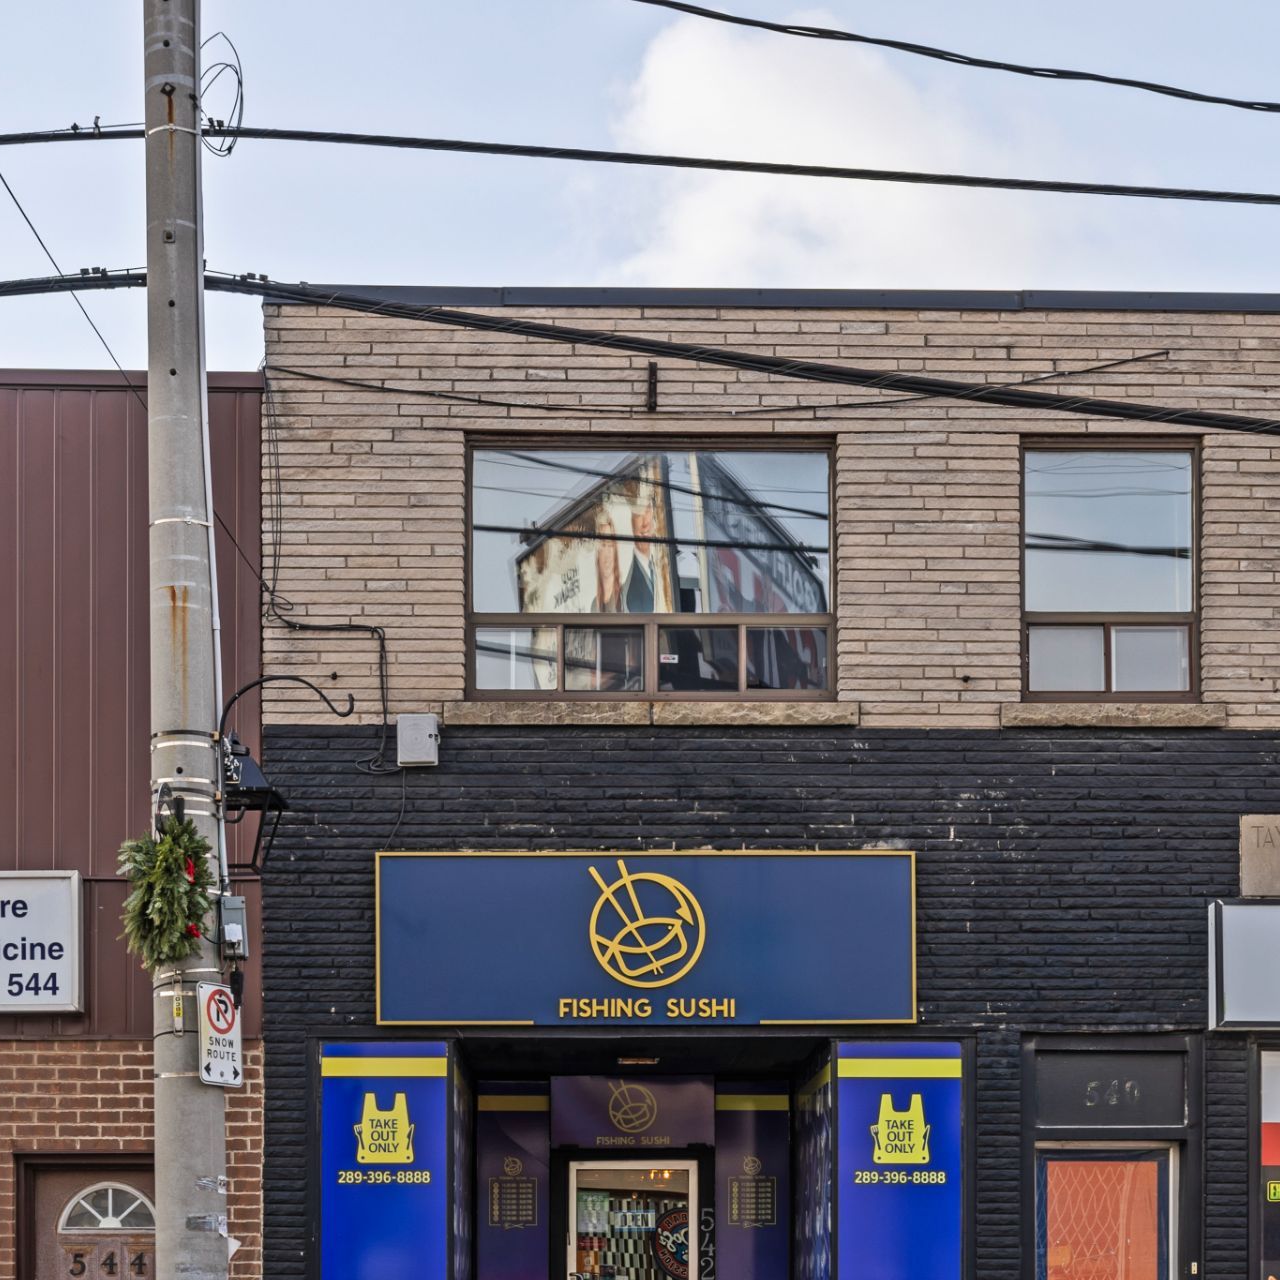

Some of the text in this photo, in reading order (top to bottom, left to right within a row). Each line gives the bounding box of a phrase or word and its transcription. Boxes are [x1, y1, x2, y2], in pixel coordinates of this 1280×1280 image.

[7, 972, 59, 997] 544
[559, 997, 736, 1018] FISHING SUSHI
[208, 1036, 234, 1049] SNOW
[207, 1049, 236, 1062] ROUTE
[368, 1118, 399, 1130] TAKE
[885, 1119, 915, 1131] TAKE
[370, 1130, 398, 1142] OUT
[596, 1136, 670, 1145] FISHING SUSHI
[886, 1131, 914, 1142] OUT
[368, 1142, 400, 1154] ONLY
[885, 1142, 916, 1154] ONLY
[337, 1171, 431, 1185] 289-396-8888
[854, 1171, 946, 1185] 289-396-8888
[700, 1208, 716, 1280] 542
[70, 1252, 147, 1276] 544
